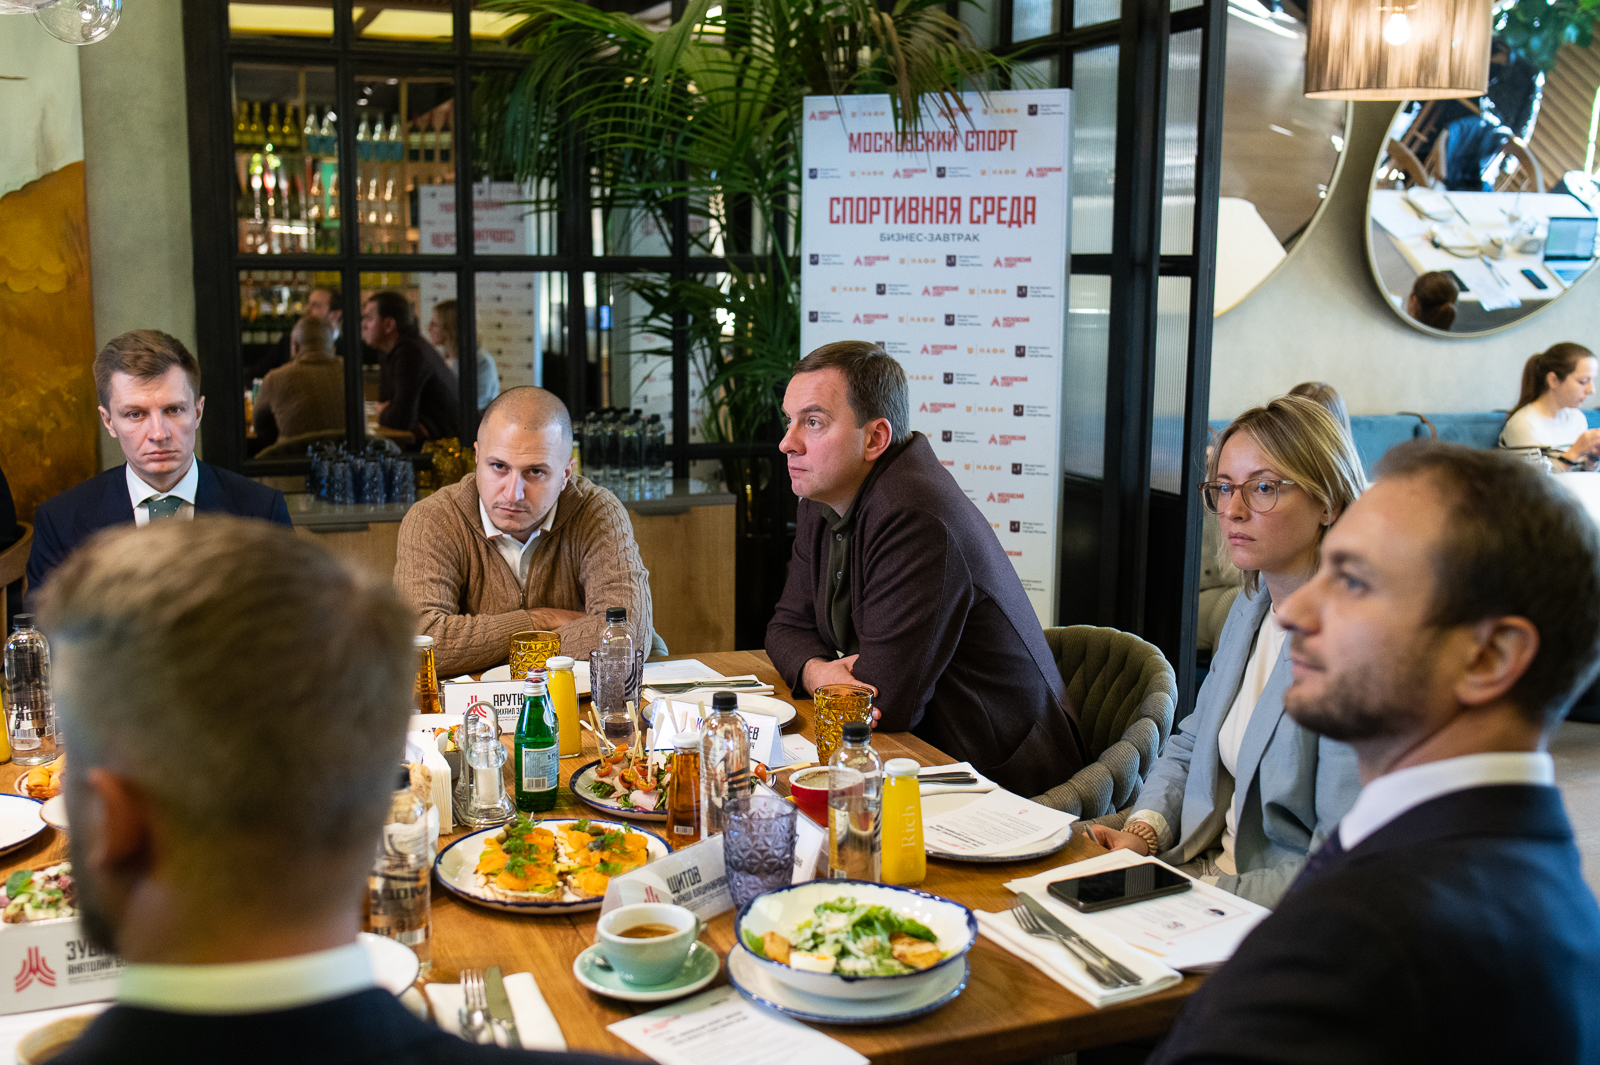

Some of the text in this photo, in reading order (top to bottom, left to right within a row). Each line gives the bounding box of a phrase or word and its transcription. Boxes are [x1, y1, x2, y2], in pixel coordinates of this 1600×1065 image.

[848, 126, 1018, 153] МОСКОВСКИЙ СПОРТ
[829, 196, 1036, 228] СПОРТИВНАЯ СРЕДА
[880, 232, 980, 242] БИЗНЕС-ЗАВТРАК
[493, 693, 524, 706] АРУТЮ
[902, 805, 916, 847] Rich
[666, 865, 702, 894] ЩИТОВ
